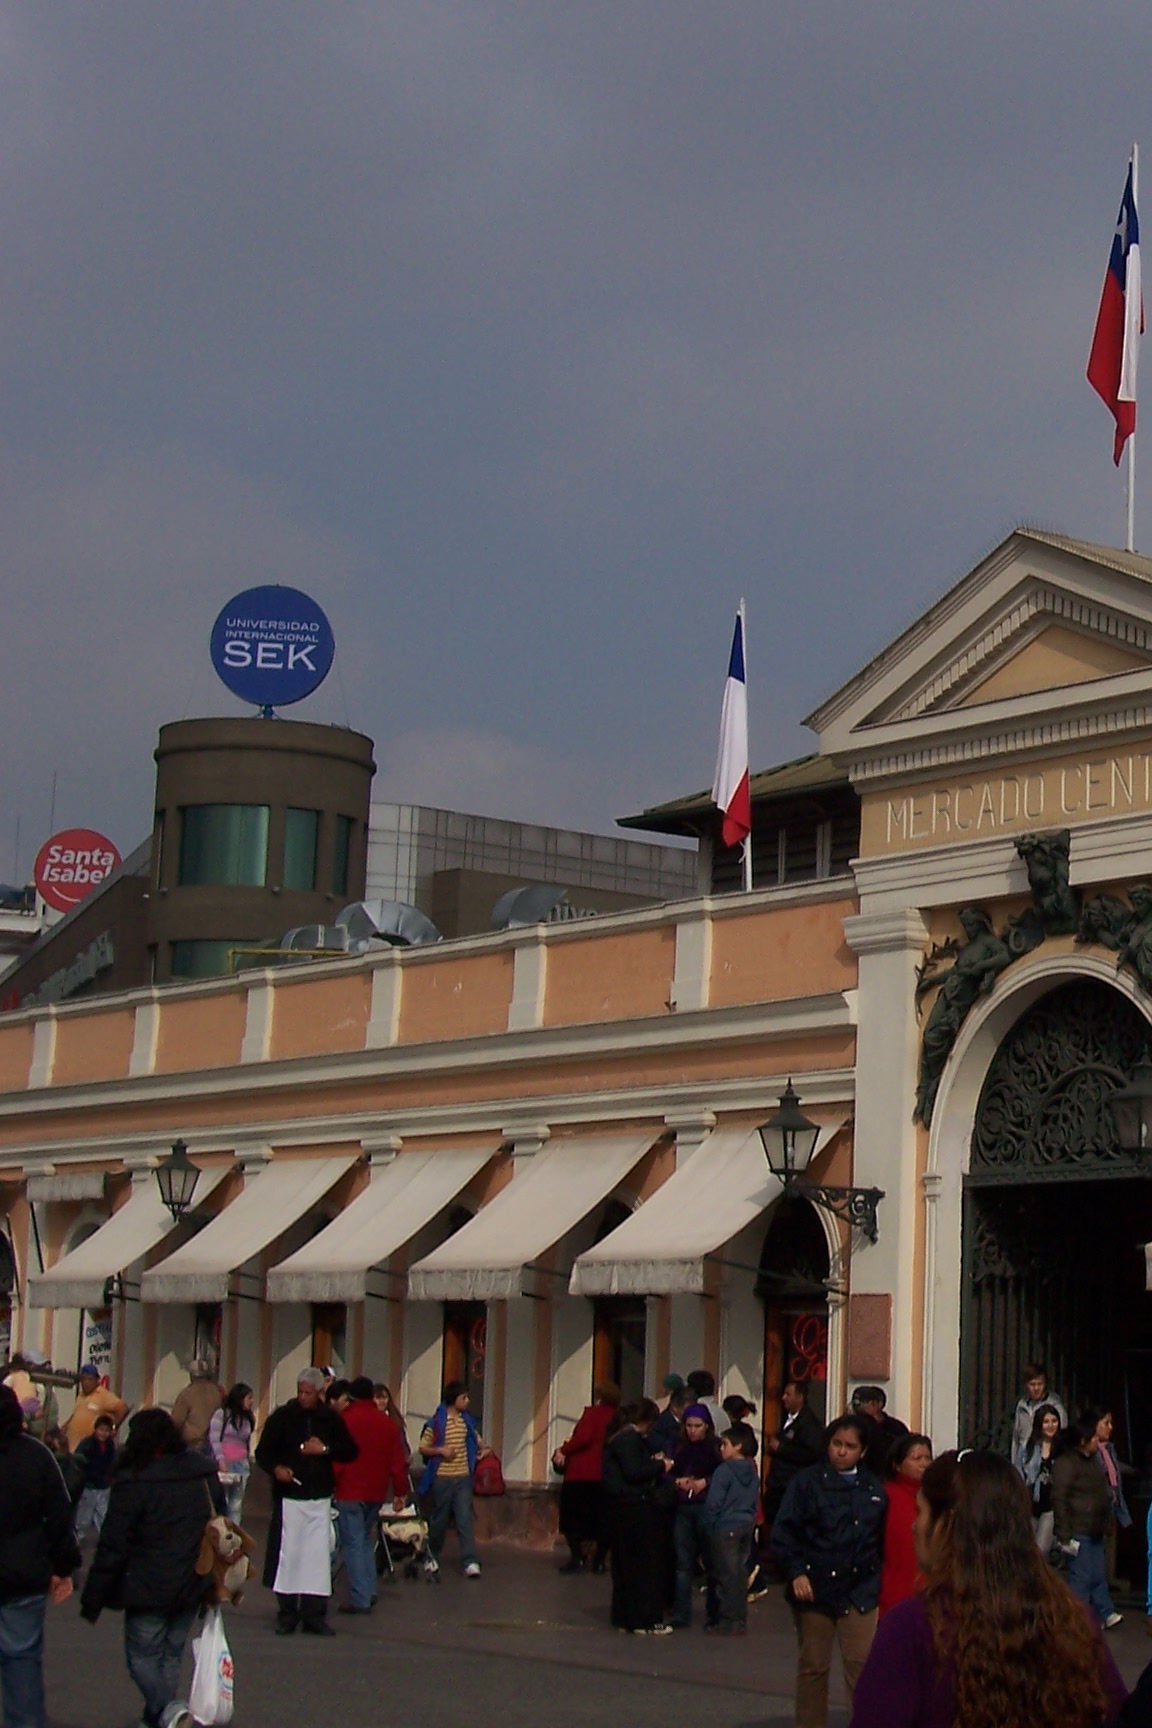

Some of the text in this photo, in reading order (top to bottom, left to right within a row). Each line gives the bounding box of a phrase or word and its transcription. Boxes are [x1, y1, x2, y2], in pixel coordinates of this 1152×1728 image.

[226, 617, 320, 631] UNIVERSIDAD
[225, 630, 319, 643] INTERNACIONAL
[223, 640, 317, 671] SEK
[885, 773, 1046, 843] MERCADO
[47, 845, 115, 867] Santa
[42, 863, 113, 884] Isabel
